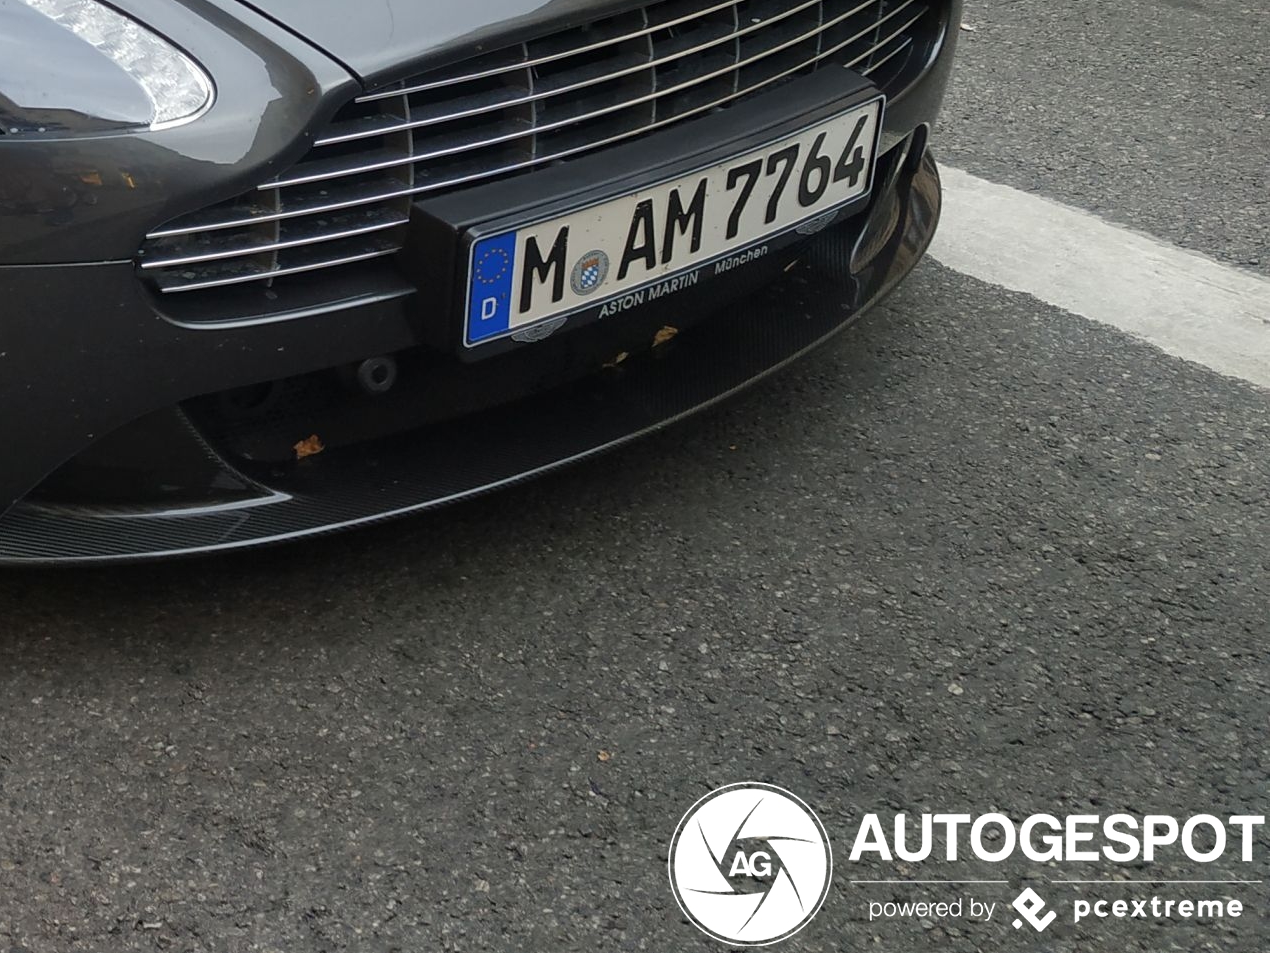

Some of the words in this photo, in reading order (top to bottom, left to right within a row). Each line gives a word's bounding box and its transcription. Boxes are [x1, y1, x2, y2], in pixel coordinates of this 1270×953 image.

[519, 226, 569, 314] M
[617, 177, 708, 281] AM
[726, 114, 869, 241] 7764
[482, 297, 497, 320] D
[598, 290, 645, 319] ASTON
[648, 270, 700, 300] MARTIN
[714, 245, 769, 276] München
